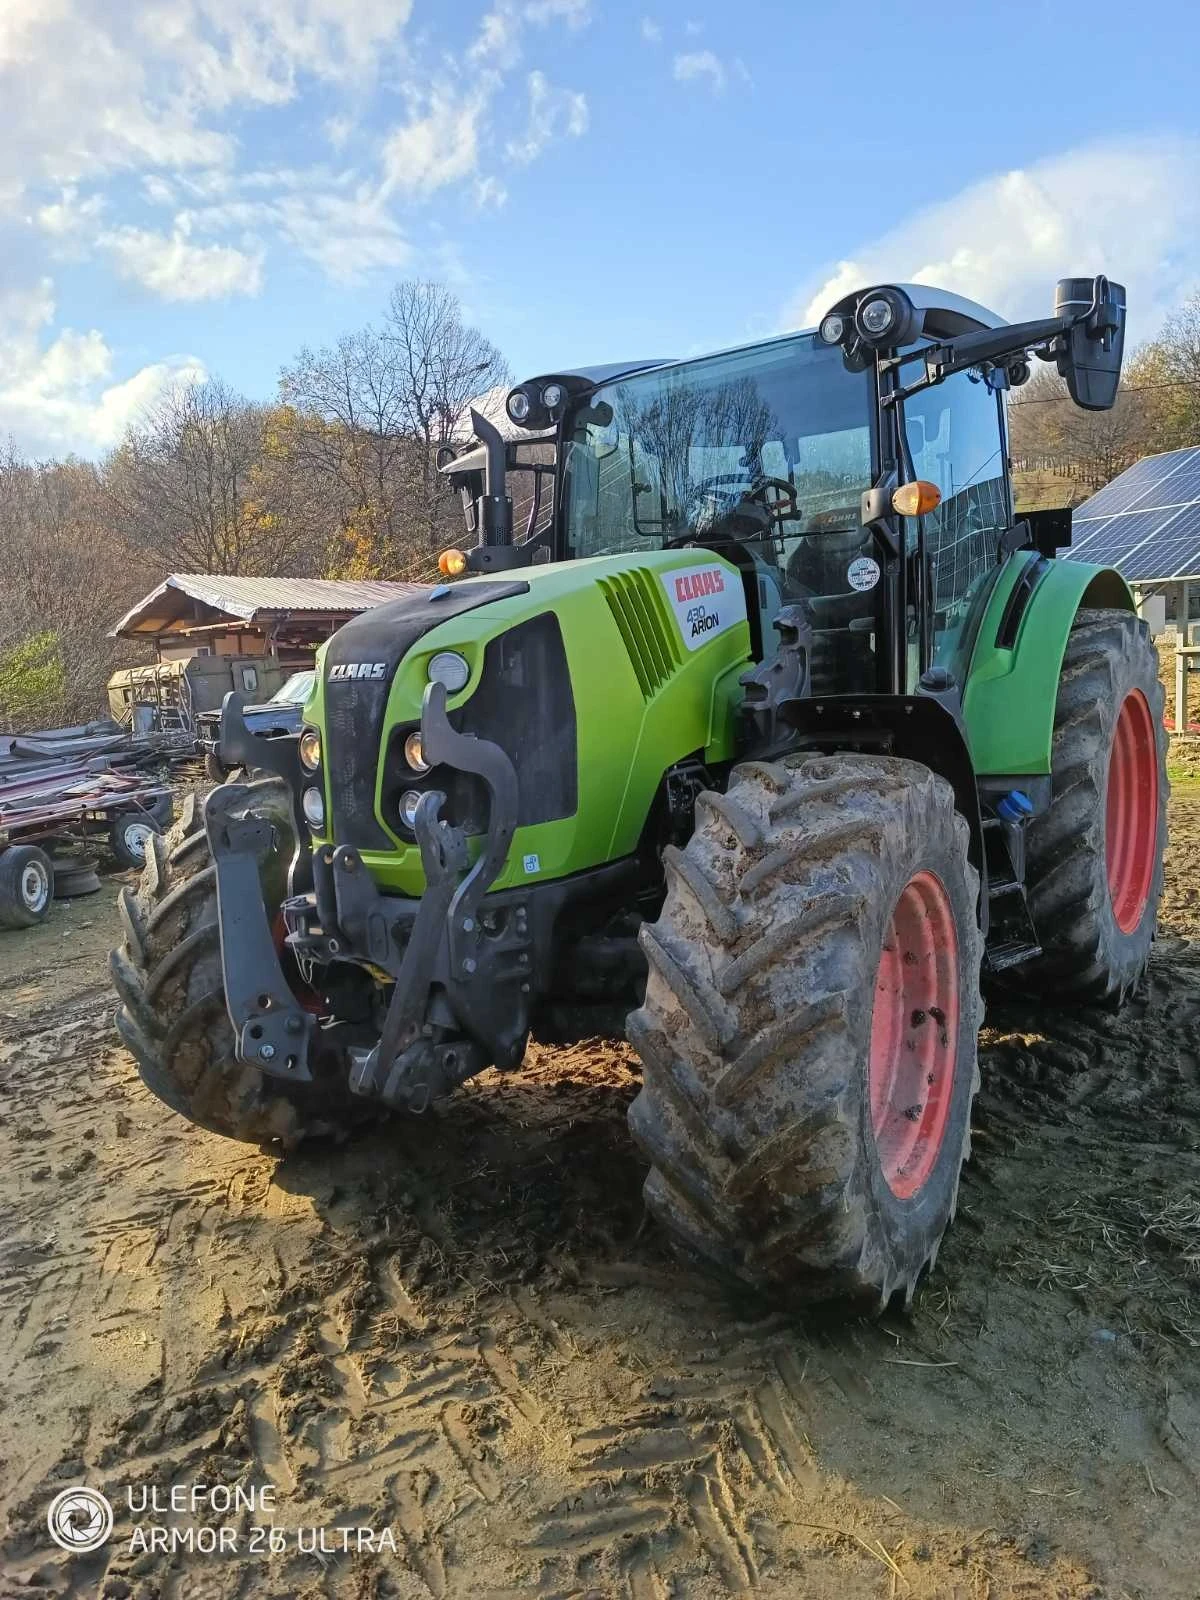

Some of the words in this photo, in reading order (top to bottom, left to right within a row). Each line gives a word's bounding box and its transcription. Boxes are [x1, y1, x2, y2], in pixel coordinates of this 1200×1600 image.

[675, 569, 725, 603] CLAAS
[686, 605, 706, 624] 430
[691, 611, 720, 638] ARION
[329, 663, 386, 681] CLAAS
